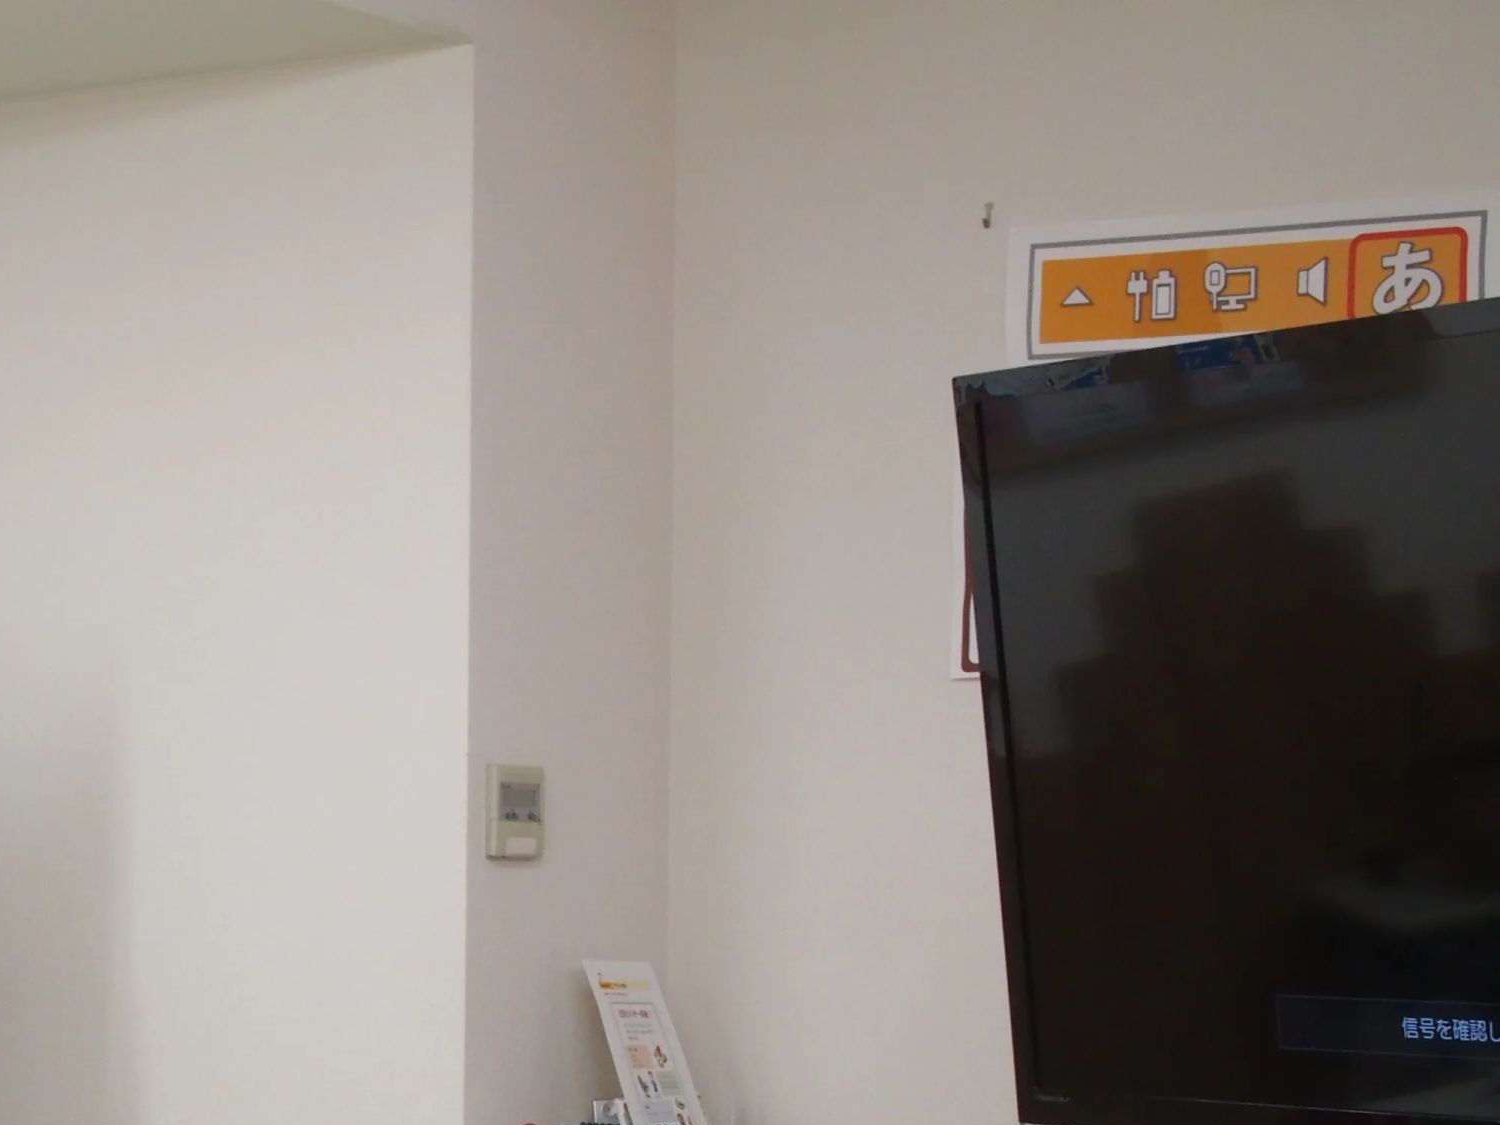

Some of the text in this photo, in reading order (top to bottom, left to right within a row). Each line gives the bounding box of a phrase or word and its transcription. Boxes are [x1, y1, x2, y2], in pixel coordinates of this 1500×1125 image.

[1372, 241, 1443, 314] あ
[1402, 1016, 1500, 1042] 信号を確認し
